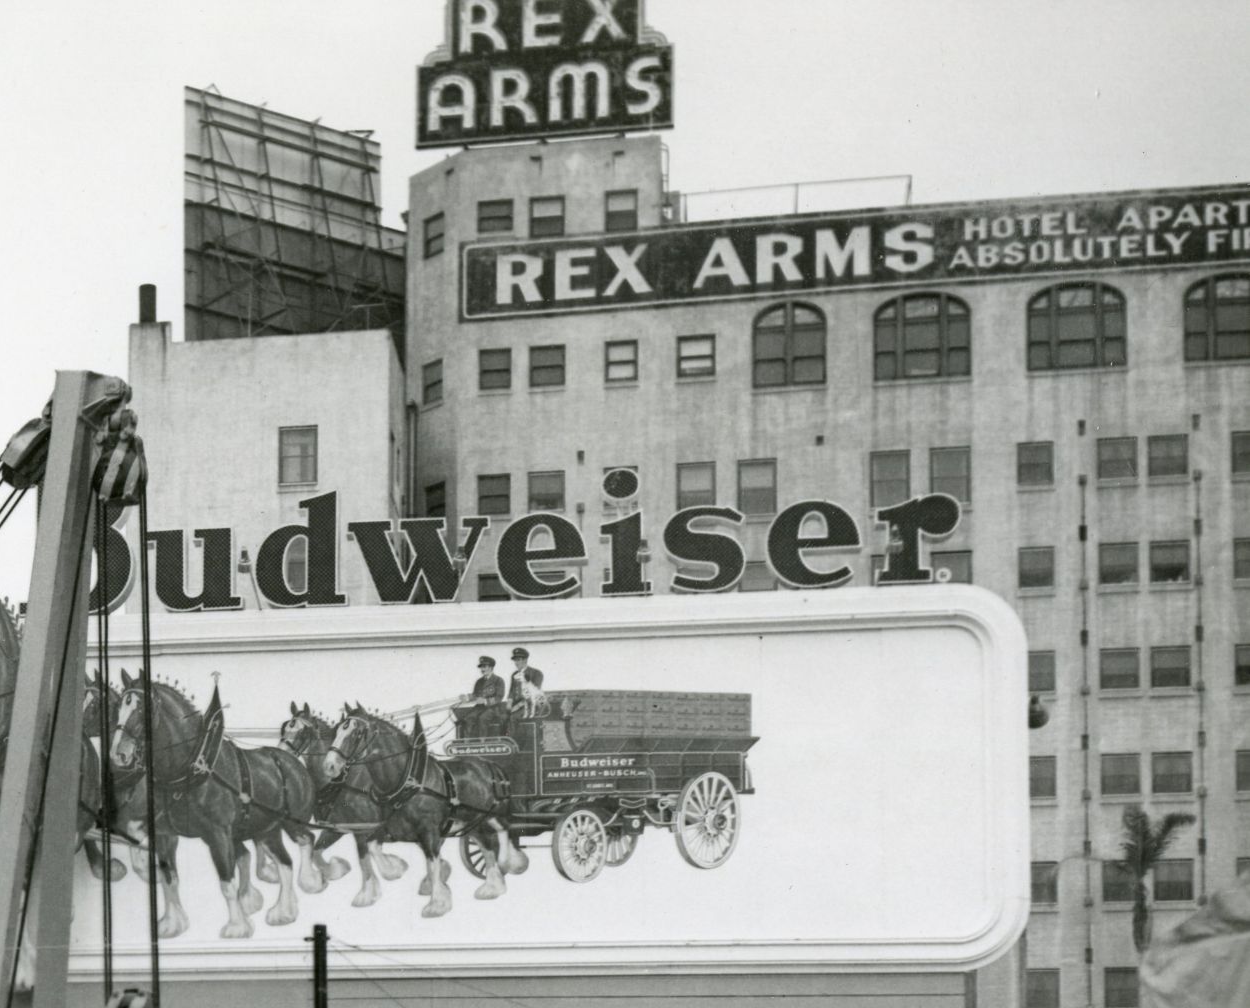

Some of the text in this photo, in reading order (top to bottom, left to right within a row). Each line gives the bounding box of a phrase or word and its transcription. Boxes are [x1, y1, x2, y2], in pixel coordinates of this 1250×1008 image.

[459, 0, 627, 53] REX
[428, 57, 662, 131] ARMS
[964, 211, 1088, 241] HOTEL
[495, 222, 935, 304] REX ARMS
[950, 231, 1192, 269] ABSOLUTELY
[560, 756, 636, 768] Budweiser
